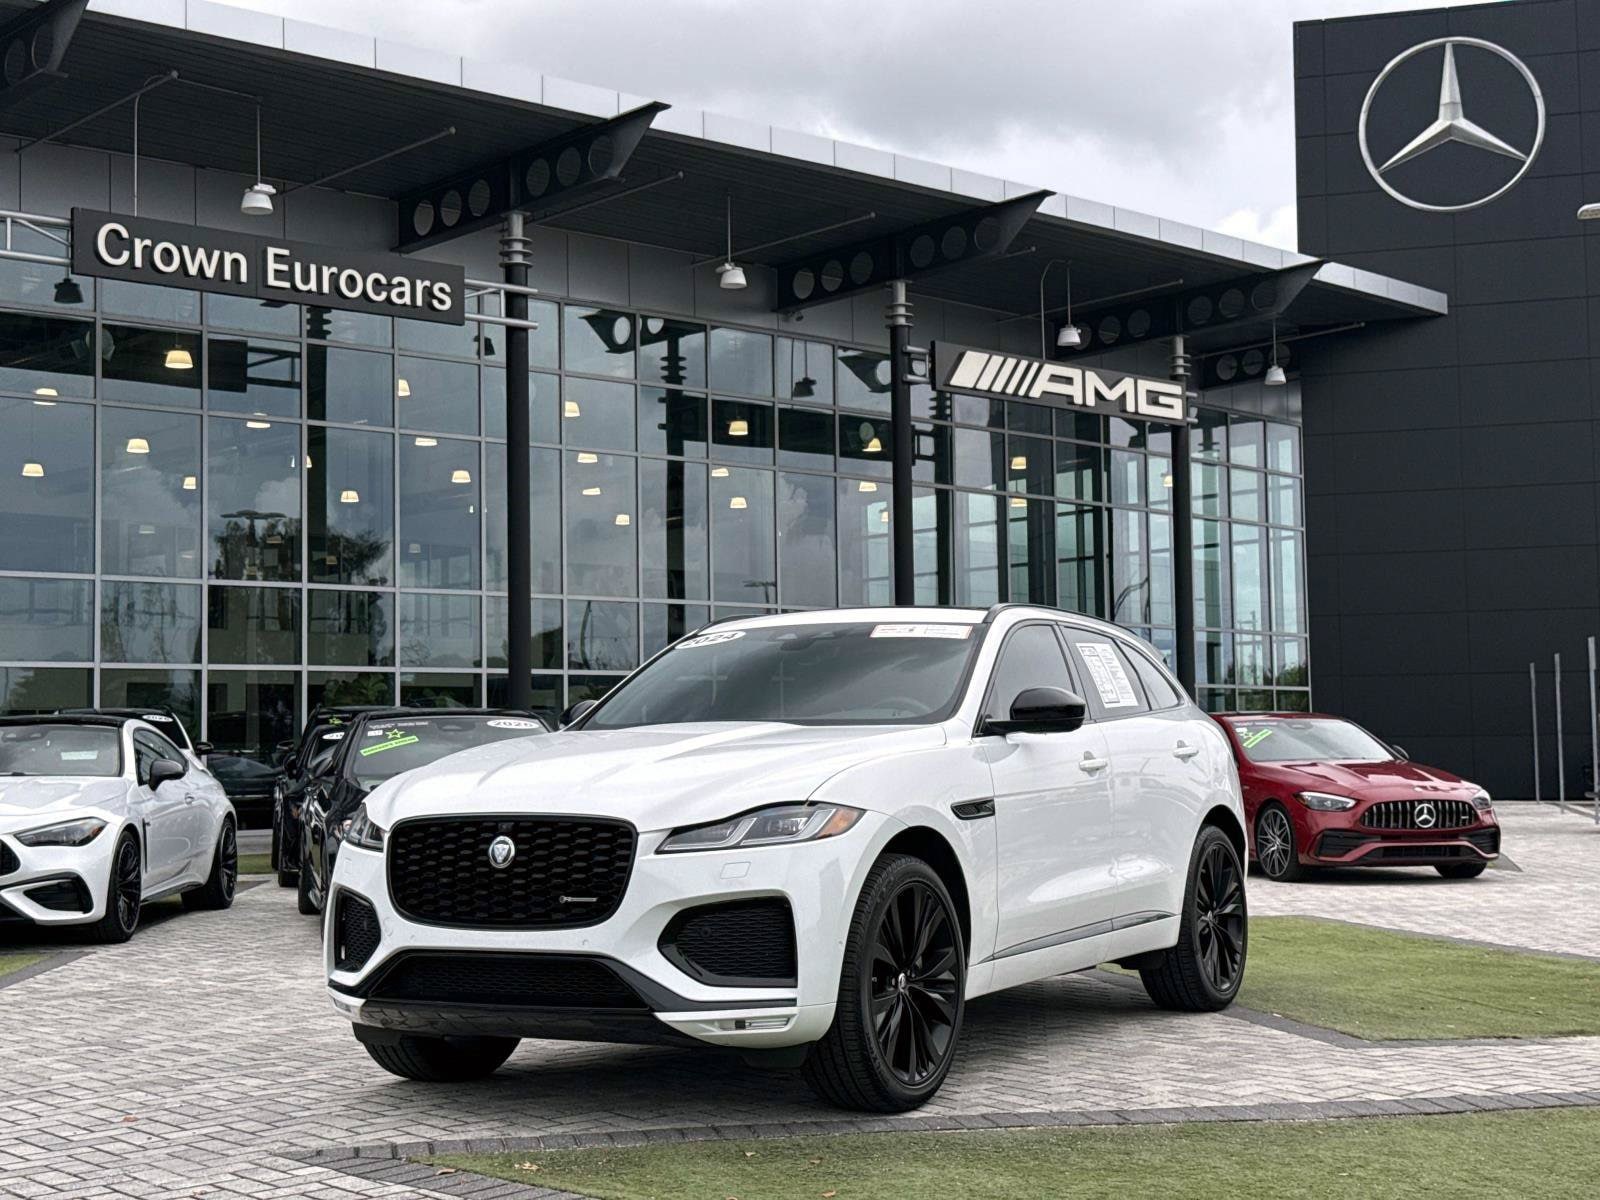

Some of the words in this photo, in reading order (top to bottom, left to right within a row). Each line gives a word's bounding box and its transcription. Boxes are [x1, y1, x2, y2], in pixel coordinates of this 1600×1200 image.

[96, 222, 248, 283] Crown
[265, 246, 453, 311] Eurocars
[1028, 363, 1183, 420] AMG
[681, 631, 739, 647] 2024
